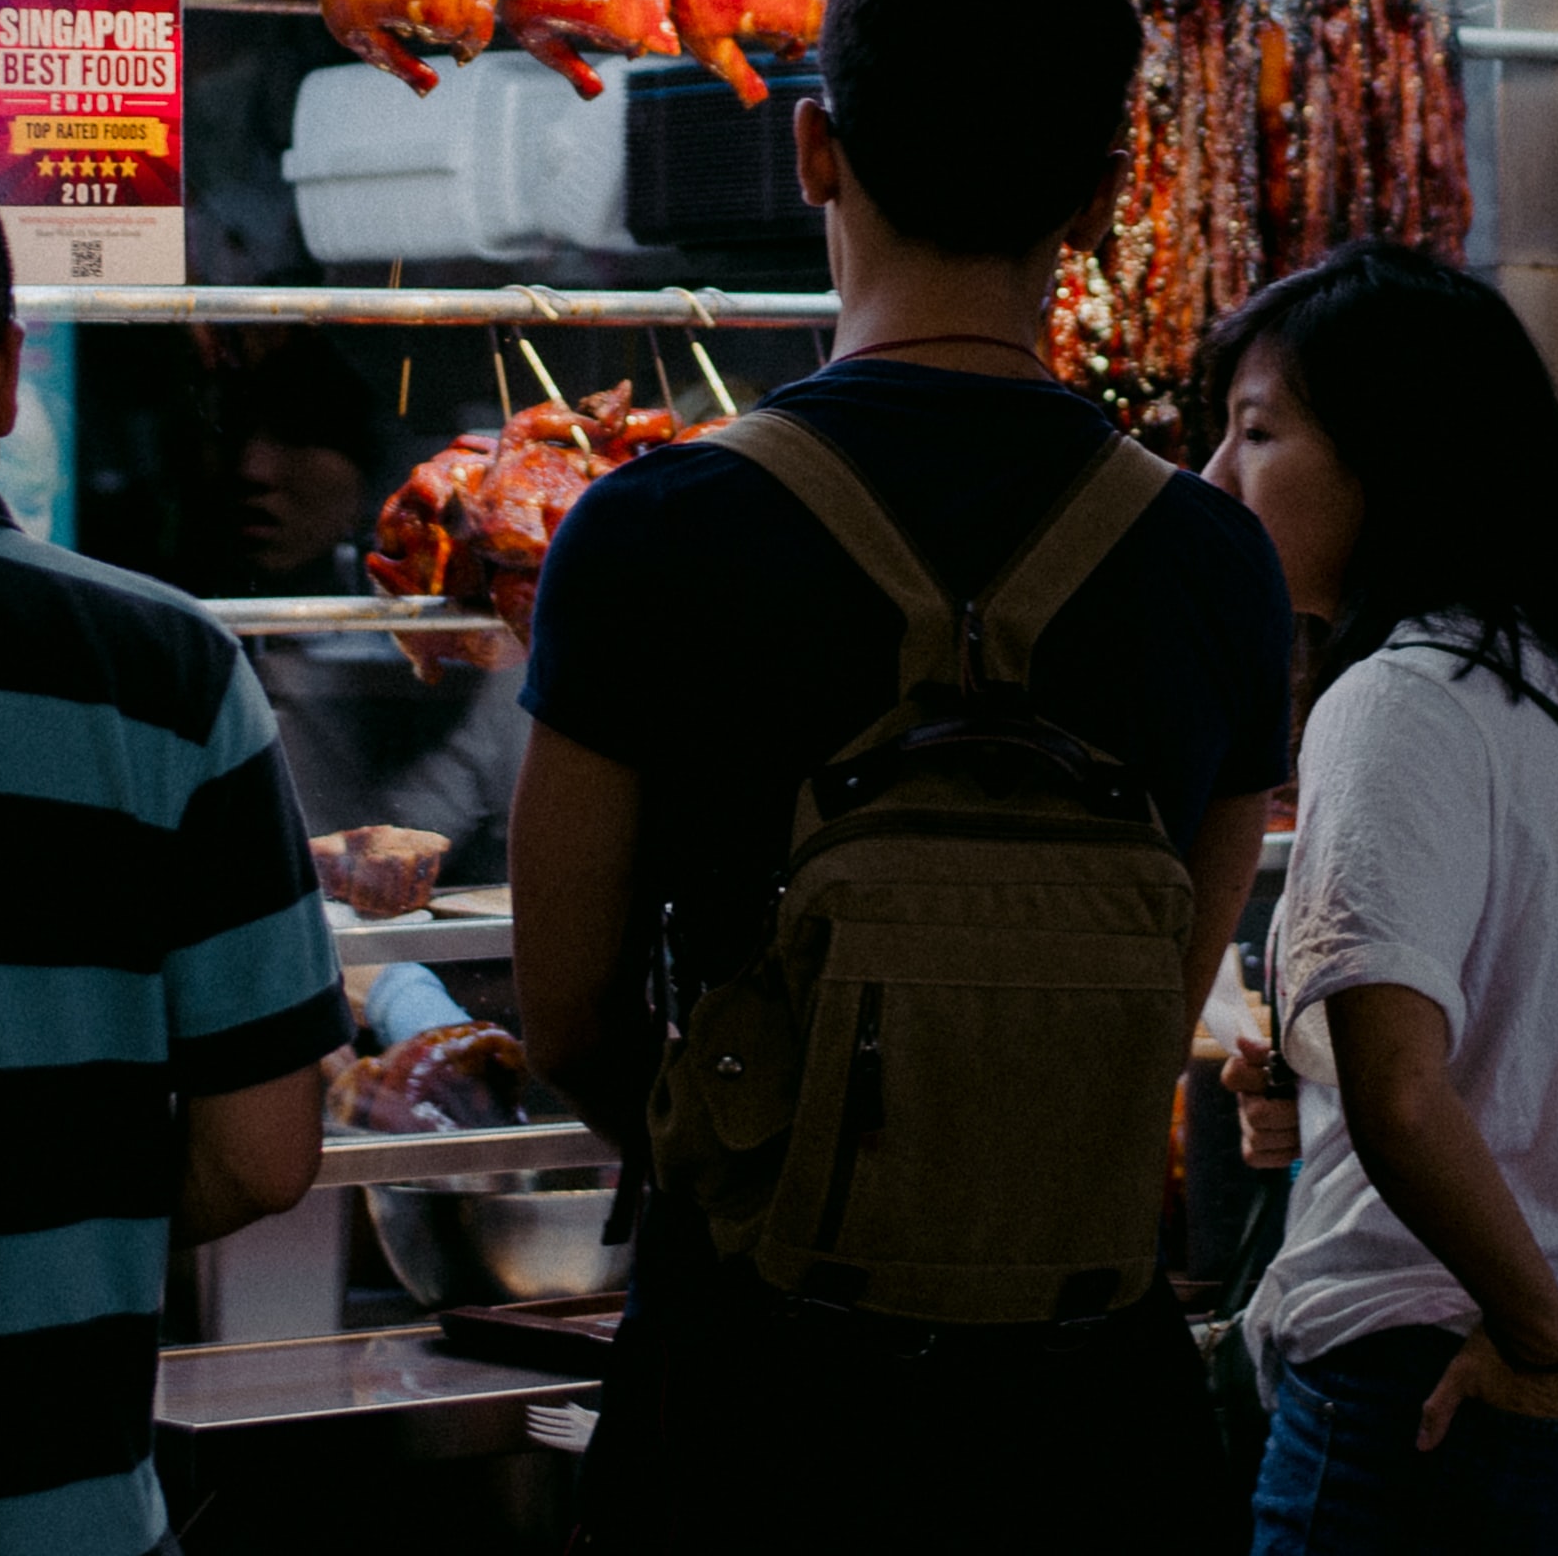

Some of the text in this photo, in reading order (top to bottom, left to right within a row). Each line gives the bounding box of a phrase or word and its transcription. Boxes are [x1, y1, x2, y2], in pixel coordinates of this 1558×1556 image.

[3, 53, 167, 88] BEST FOODS
[50, 94, 123, 112] ENJOY
[26, 122, 147, 140] TOP RATED FOODS
[61, 182, 118, 204] 2017
